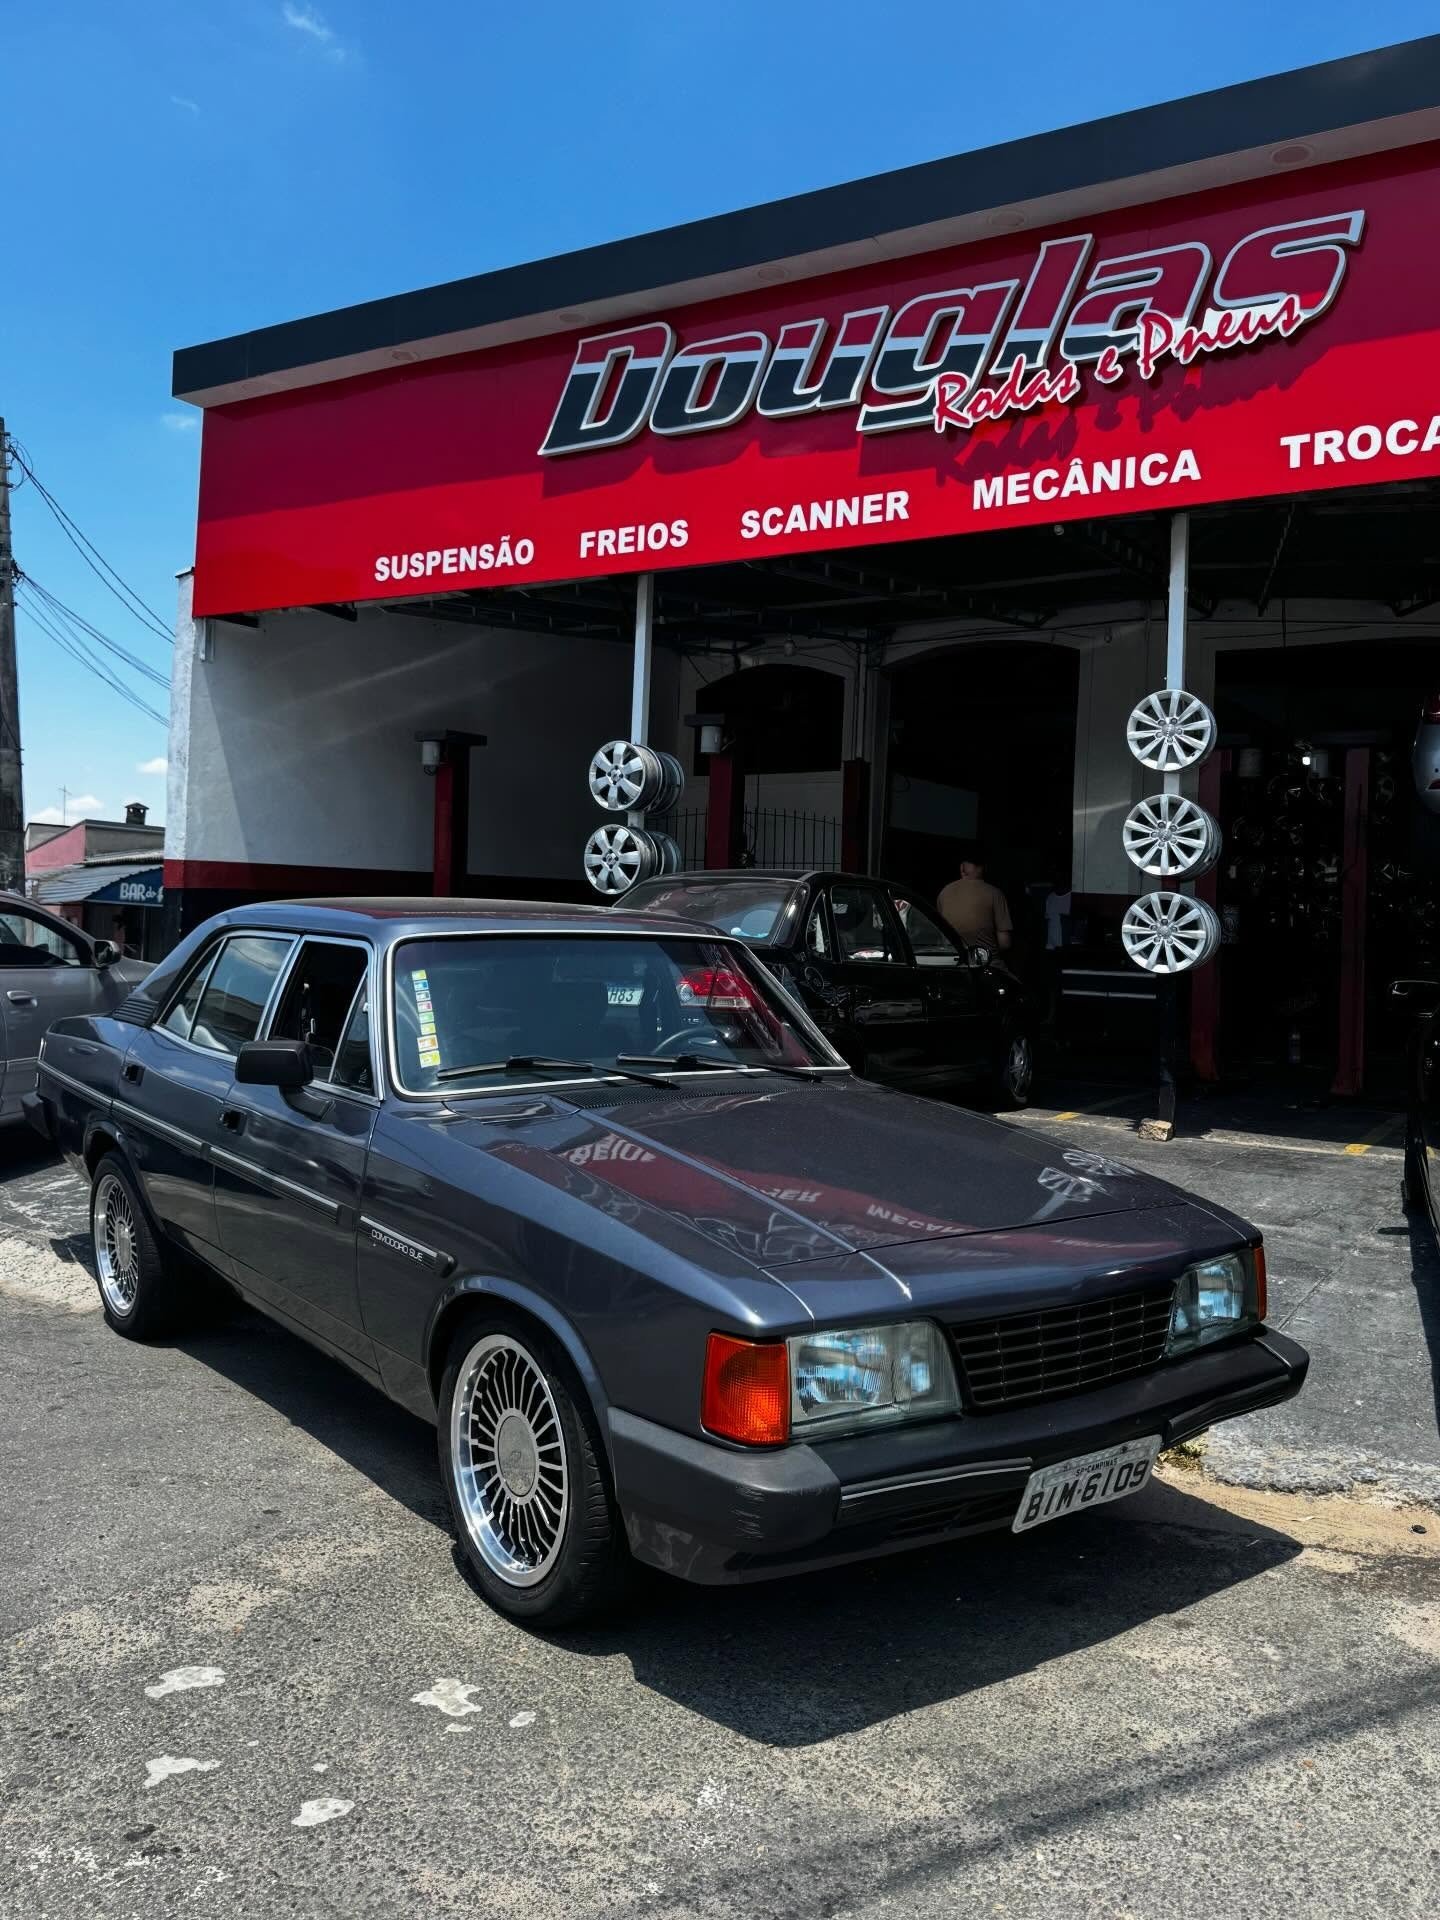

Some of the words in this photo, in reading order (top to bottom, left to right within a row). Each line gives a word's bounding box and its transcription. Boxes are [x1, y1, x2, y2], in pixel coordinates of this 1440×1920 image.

[537, 209, 1365, 456] Douglas
[933, 351, 1080, 432] Rodas
[1094, 346, 1123, 383] e
[1137, 294, 1302, 379] Pneus
[374, 535, 535, 582] SUSPENSÃO
[580, 519, 689, 559] FREIOS
[740, 490, 910, 539] SCANNER
[973, 449, 1201, 510] MECÂNICA
[120, 882, 146, 901] BAR
